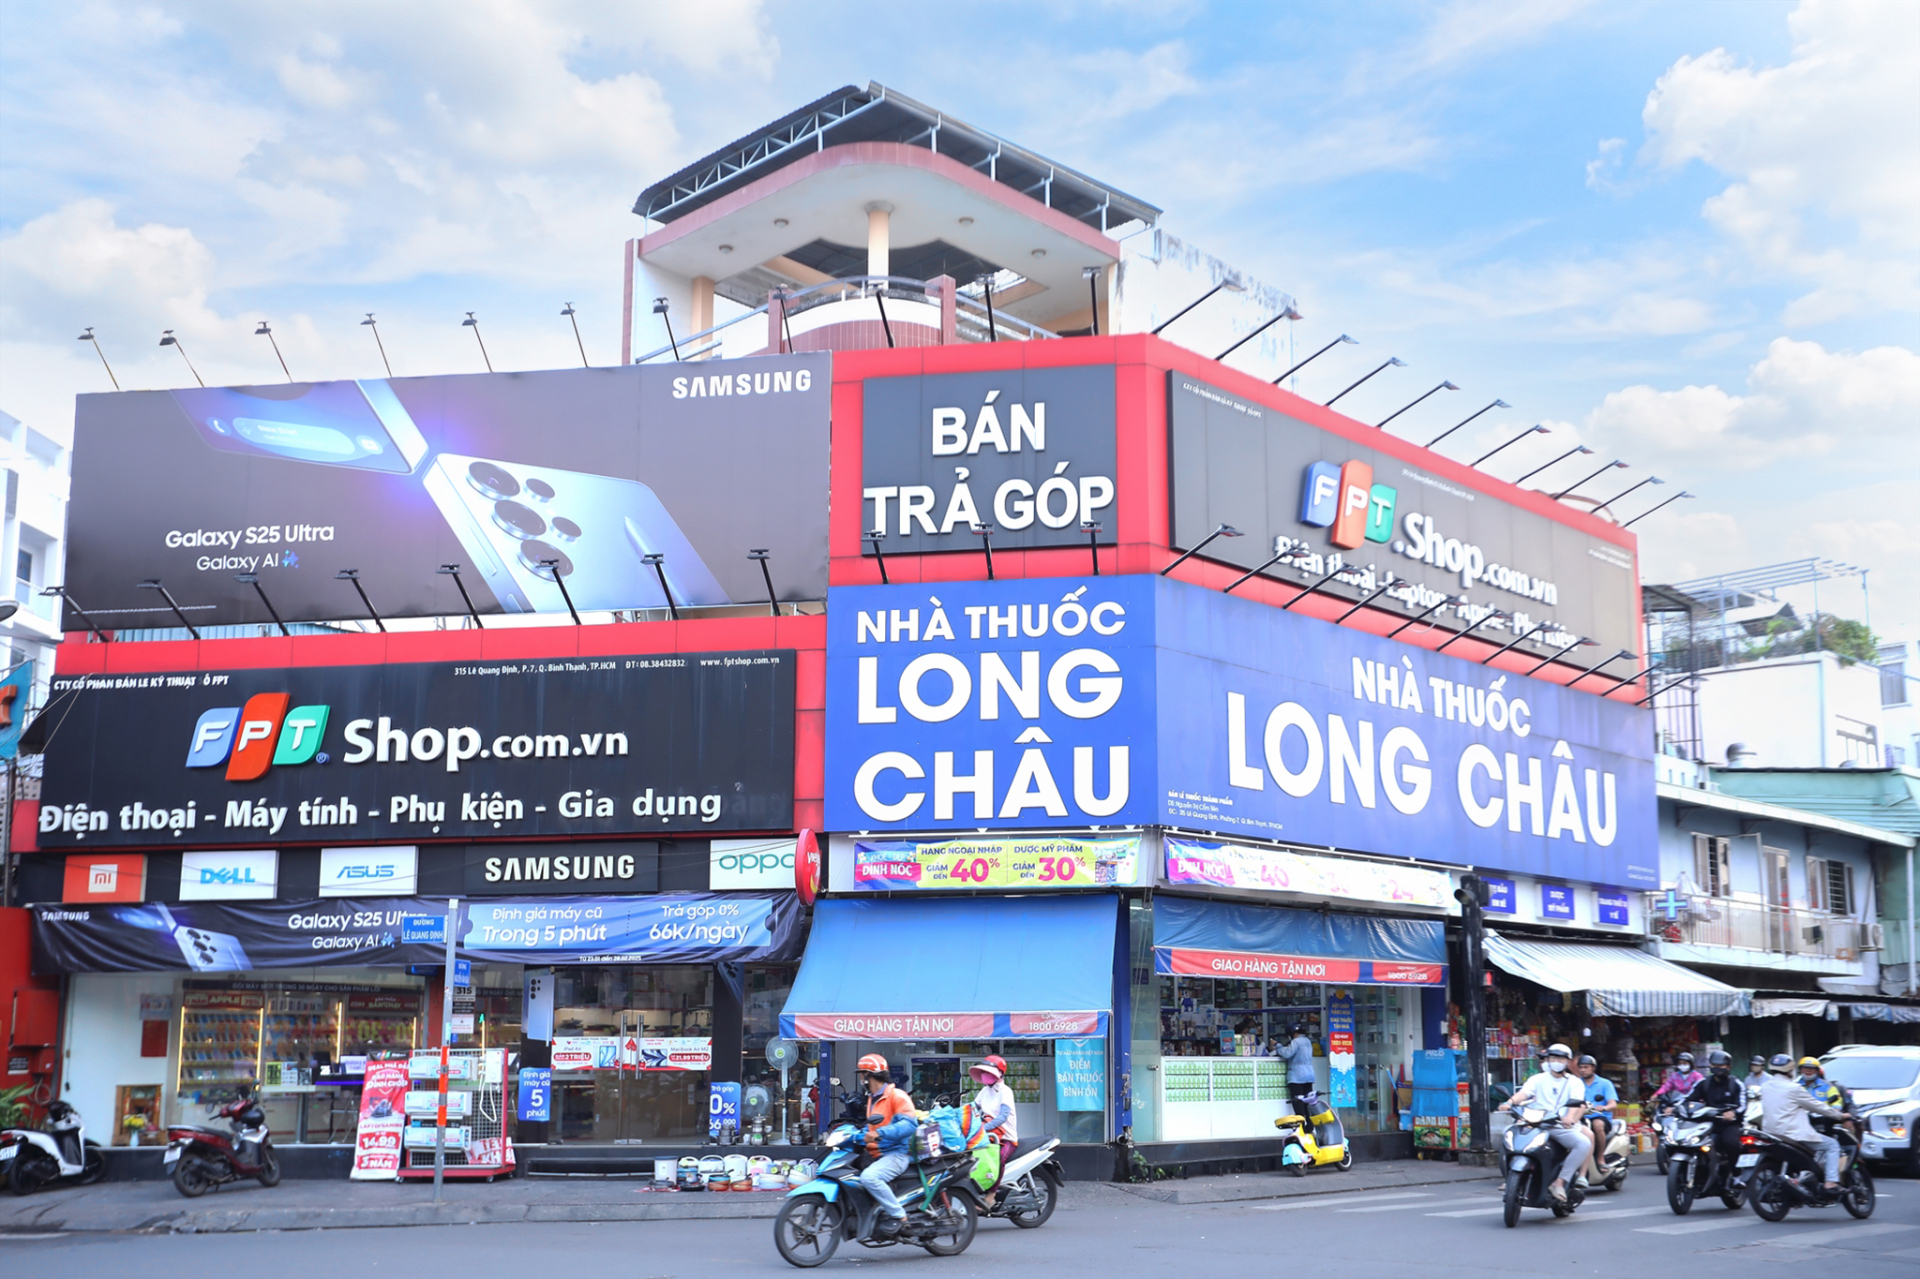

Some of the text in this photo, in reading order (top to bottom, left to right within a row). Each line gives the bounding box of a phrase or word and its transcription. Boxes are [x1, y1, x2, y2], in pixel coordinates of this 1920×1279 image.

[672, 369, 811, 399] SAMSUNG
[932, 390, 1045, 456] BÁN
[863, 461, 1115, 537] TRẢ GÓP
[1311, 471, 1394, 530] FPT
[165, 523, 335, 550] Galaxy S25 Ultra
[196, 552, 279, 573] Galaxy AI
[1274, 535, 1325, 579] Điện
[1326, 553, 1376, 596] thoại
[857, 585, 1126, 644] NHÀ THUỐC
[478, 666, 500, 677] Quang
[54, 679, 72, 691] CTY
[115, 675, 137, 690] BÁN
[212, 675, 230, 686] FPT
[858, 648, 1124, 724] LONG
[1352, 654, 1531, 738] NHÀ THUỐC
[343, 715, 629, 772] Shop.com.vn
[854, 726, 1130, 823] CHÂU
[1227, 691, 1618, 848] LONG CHÂU
[39, 788, 722, 840] Điện thoại Máy tính Phụ kiện Gia dụng
[200, 866, 256, 885] DELL
[336, 864, 395, 879] ASUS
[485, 854, 635, 882] SAMSUNG
[950, 857, 1000, 883] 40%
[1038, 856, 1087, 882] 30%
[41, 911, 90, 921] SAMSUNG
[288, 913, 351, 932] Galaxy
[353, 911, 383, 926] S25
[492, 906, 603, 923] Định giá máy cũ
[662, 903, 740, 920] Trả góp 0%
[312, 934, 379, 952] Galaxy AI
[403, 930, 444, 941] LÊ QUANG ĐỊNH
[482, 925, 607, 947] Trong 5 phút
[650, 922, 750, 946] 66k/ngày
[1211, 957, 1326, 979] GIAO HÀNG TẬN NƠI
[210, 995, 240, 1004] APPLE
[456, 987, 472, 995] 315
[834, 1015, 954, 1037] GIAO HÀNG TẬN NƠI
[1028, 1020, 1078, 1032] 1800 6928
[1069, 1057, 1091, 1070] ĐIỂM
[523, 1071, 550, 1080] Định giá
[524, 1078, 550, 1088] máy cũ
[1057, 1070, 1104, 1083] BÁN THUỐC
[530, 1089, 544, 1107] 5
[721, 1085, 735, 1094] góp
[1063, 1086, 1084, 1098] BÌNH
[526, 1107, 546, 1120] phút
[709, 1093, 736, 1115] 0%
